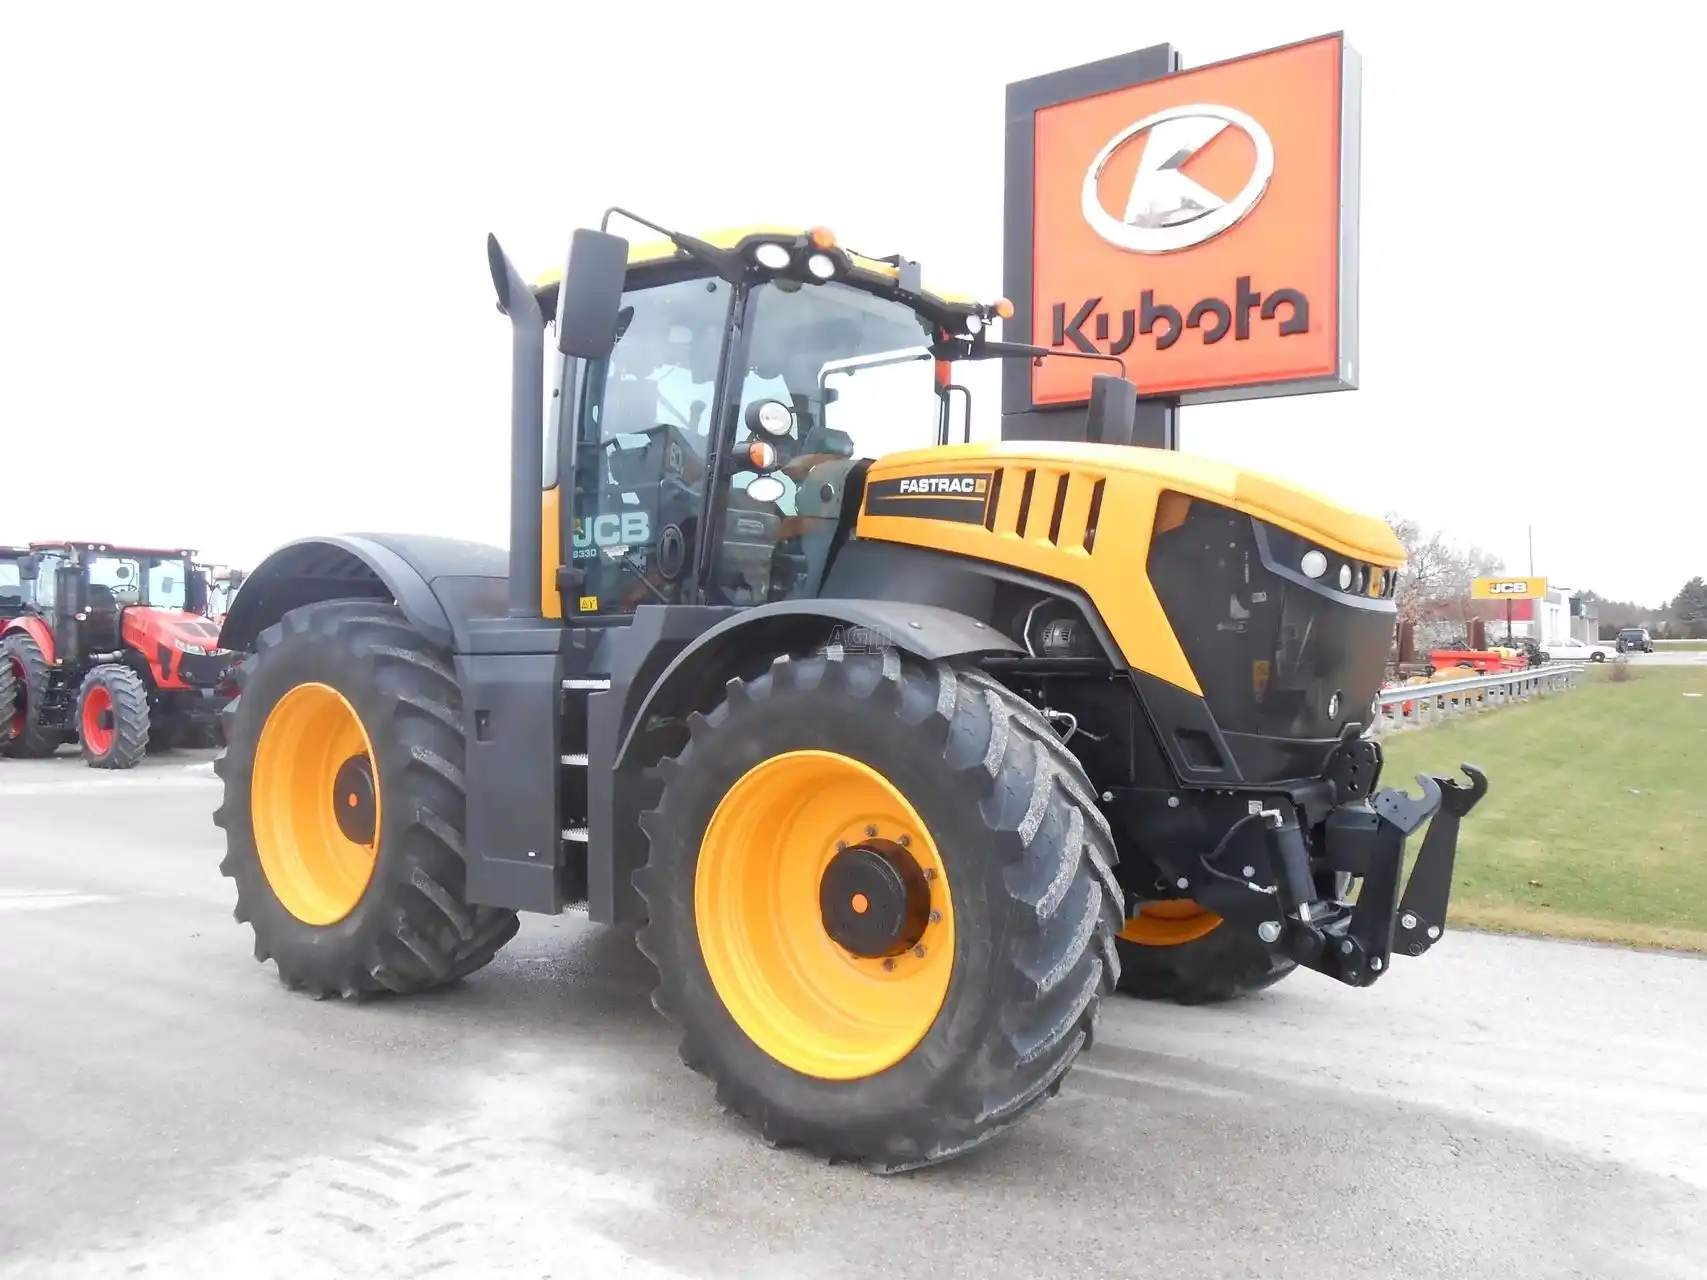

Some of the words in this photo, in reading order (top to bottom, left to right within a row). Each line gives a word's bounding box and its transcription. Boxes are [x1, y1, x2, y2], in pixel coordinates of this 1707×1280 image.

[1052, 276, 1309, 355] Kubota
[899, 478, 975, 493] FASTRAC
[573, 512, 650, 547] JCB
[1489, 582, 1528, 594] JCB
